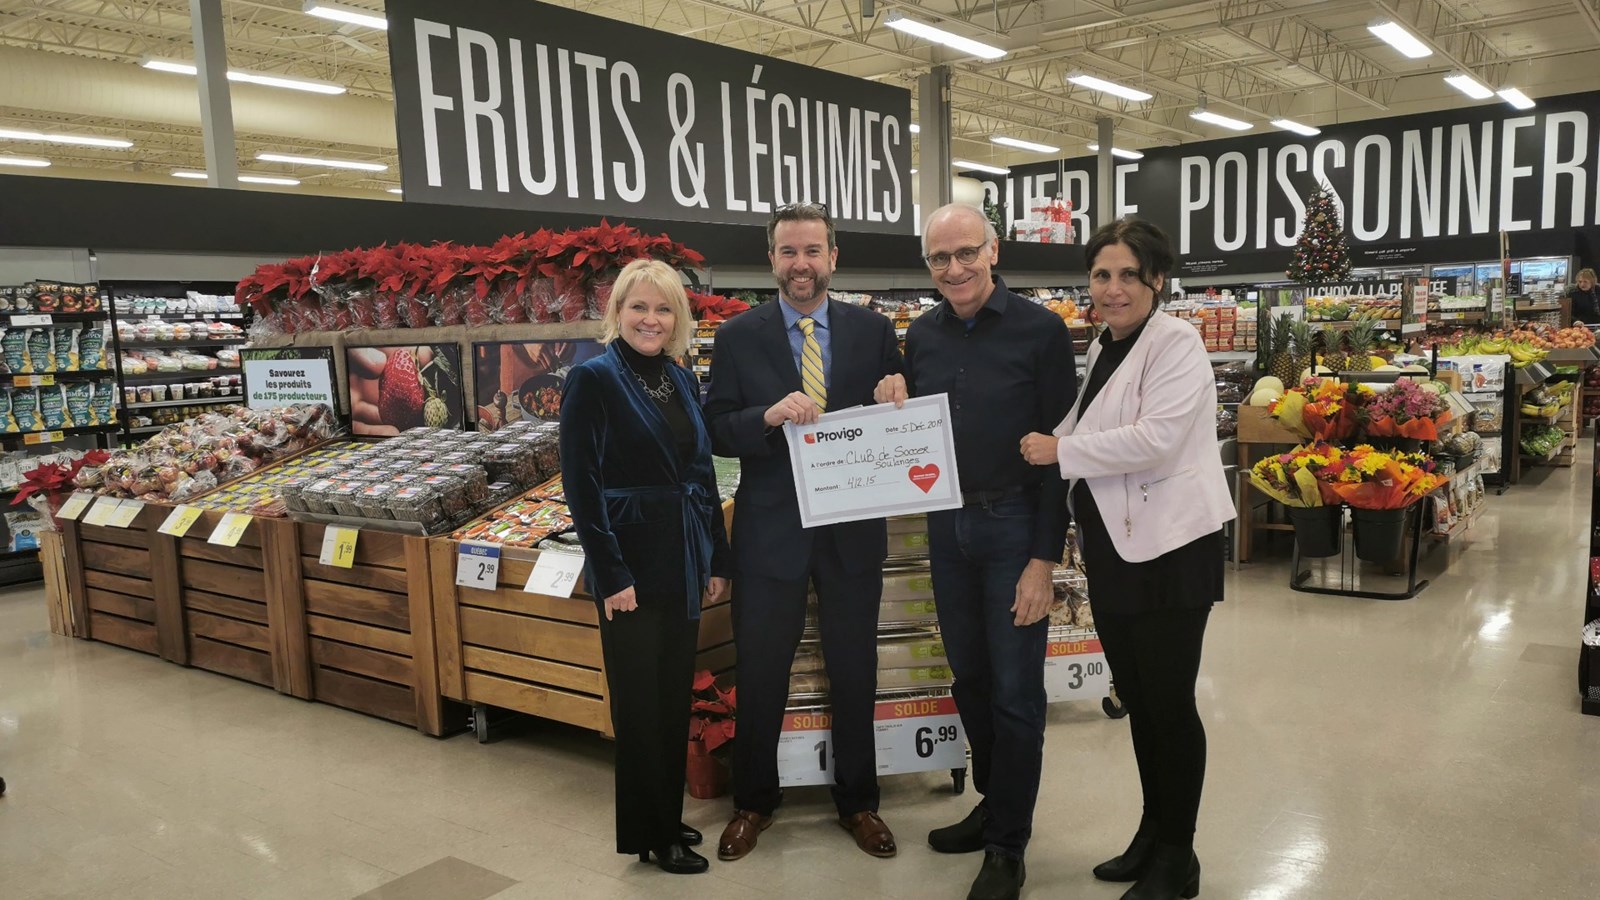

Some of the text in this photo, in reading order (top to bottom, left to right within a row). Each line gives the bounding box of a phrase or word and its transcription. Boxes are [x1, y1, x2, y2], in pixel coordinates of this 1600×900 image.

[414, 17, 901, 223] FRUITS & LÉGUMES
[1317, 284, 1353, 296] CHOIX
[268, 368, 306, 378] Savourez
[265, 379, 312, 391] les produits
[253, 391, 328, 402] de 175 producteurs
[899, 423, 908, 434] 5
[927, 419, 943, 430] 2019
[816, 427, 863, 443] Provigo
[879, 445, 891, 461] de
[477, 561, 495, 581] 2,99
[1051, 641, 1089, 656] SOLDE
[1067, 661, 1104, 690] 3,00
[894, 700, 938, 717] SOLDE
[915, 725, 958, 759] 6,99
